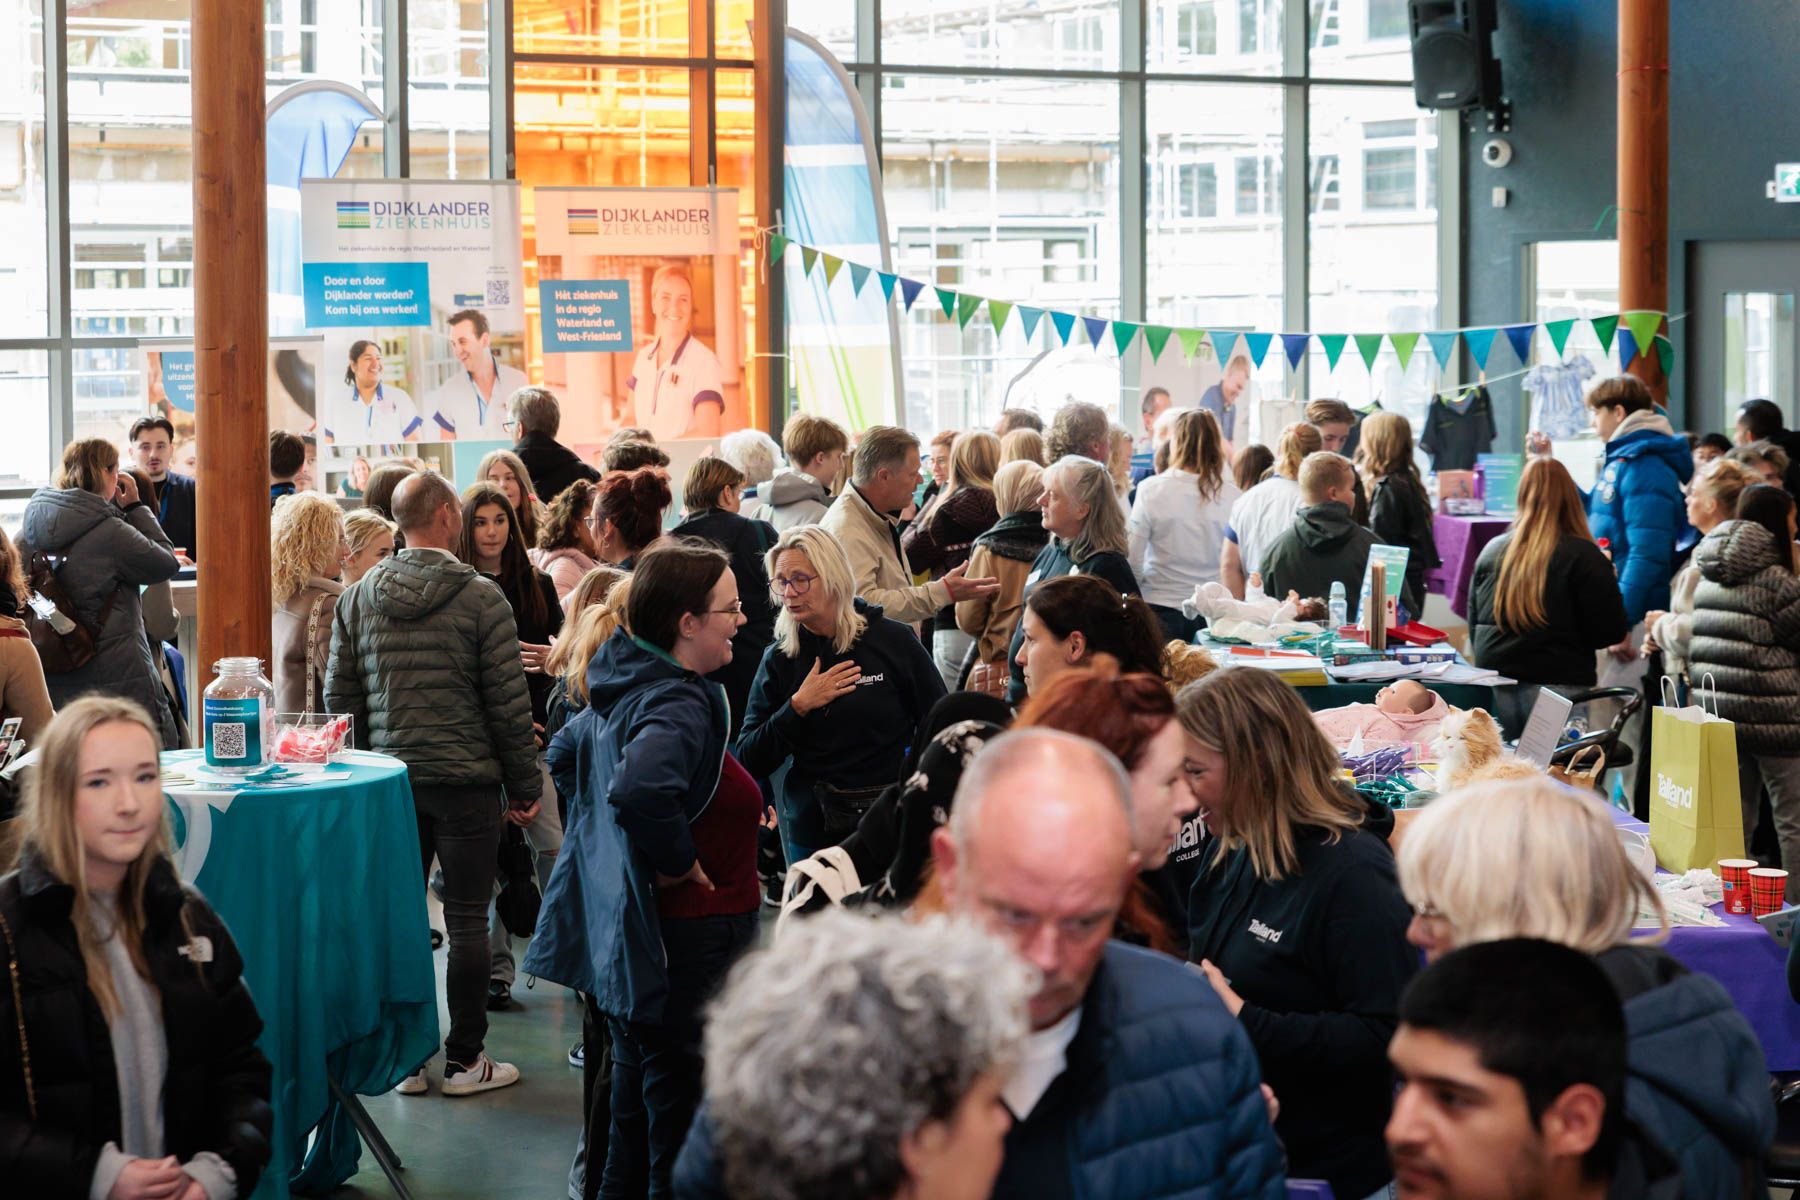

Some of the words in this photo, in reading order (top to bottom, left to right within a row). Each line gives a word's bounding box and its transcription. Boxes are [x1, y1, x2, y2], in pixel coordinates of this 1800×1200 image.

[374, 201, 489, 216] DIJKLANDER
[602, 208, 709, 222] DIJKLANDER
[375, 216, 491, 229] ZIEKENHUIS
[603, 222, 711, 236] ZIEKENHUIS
[324, 276, 348, 286] Door
[350, 278, 361, 286] en
[363, 275, 386, 286] door
[325, 290, 372, 302] Dijklander
[374, 289, 414, 300] worden?
[573, 289, 619, 300] ziekenhuis
[325, 305, 348, 315] Kom
[350, 304, 361, 317] bij
[382, 304, 418, 314] werken!
[556, 304, 565, 314] in
[566, 304, 577, 314] de
[579, 304, 602, 316] regio
[556, 318, 602, 327] Waterland
[557, 331, 622, 341] West-Friesland
[1657, 772, 1693, 809] Talland
[1247, 918, 1284, 943] Talland
